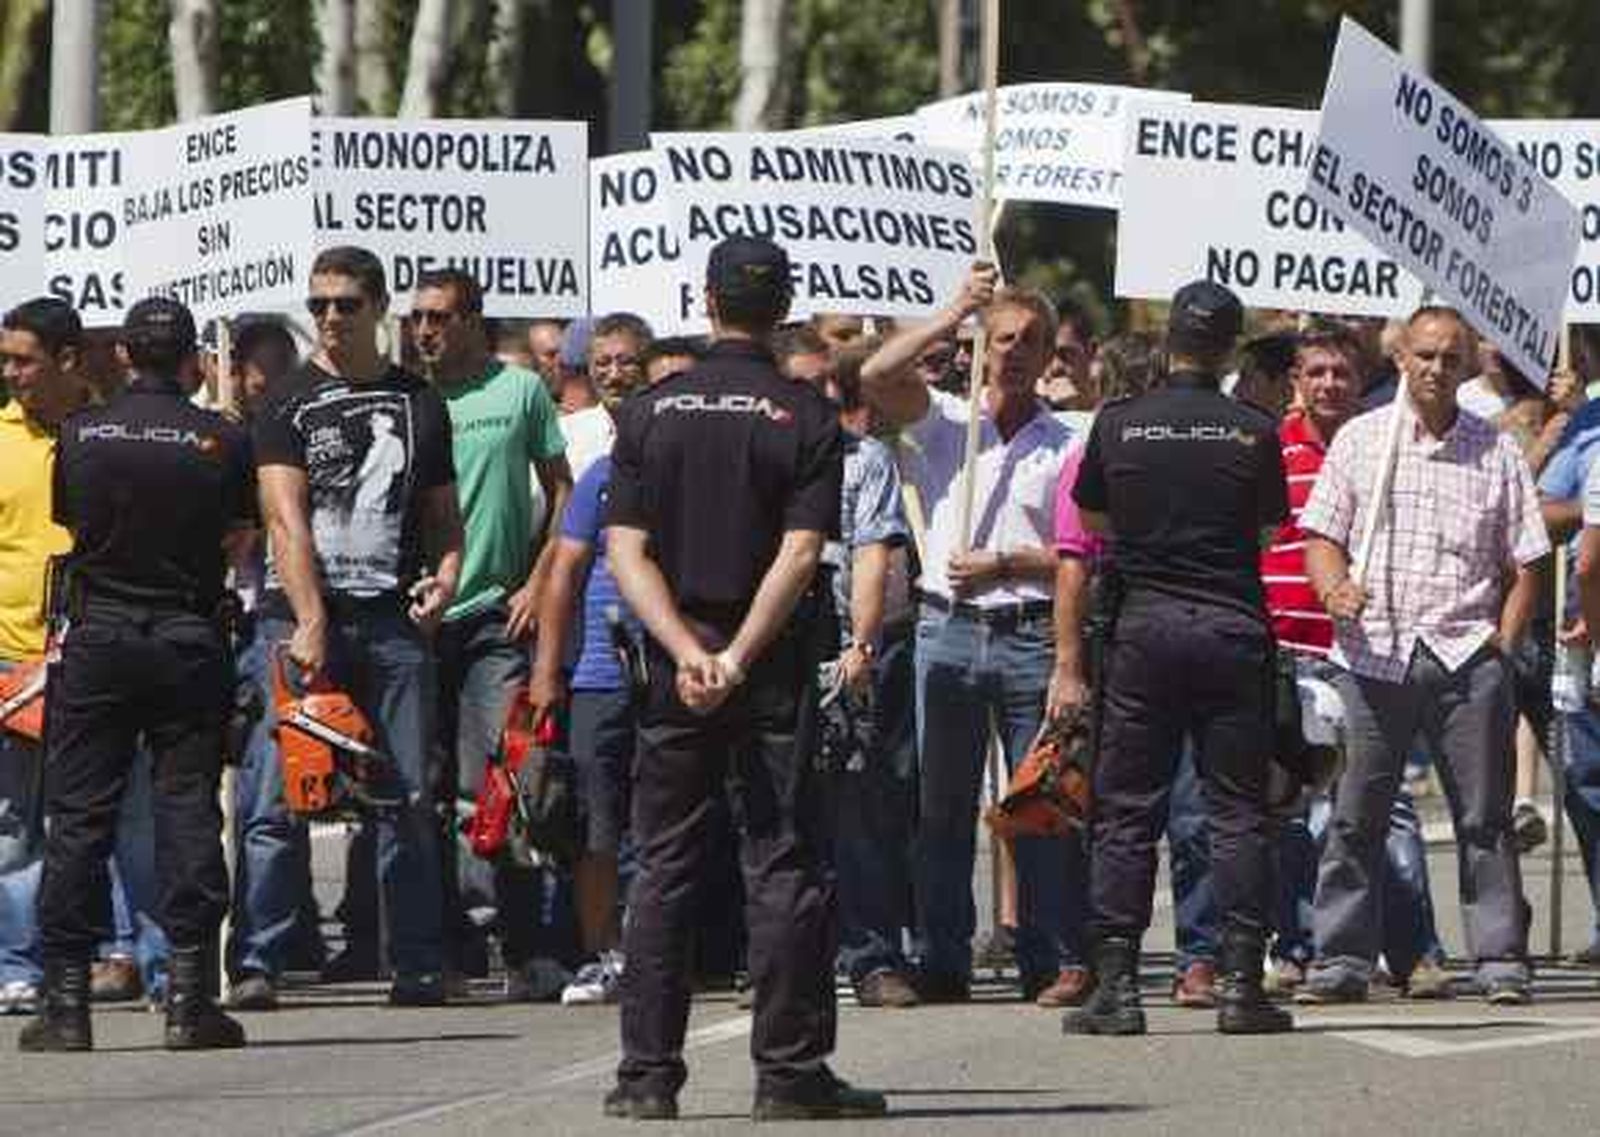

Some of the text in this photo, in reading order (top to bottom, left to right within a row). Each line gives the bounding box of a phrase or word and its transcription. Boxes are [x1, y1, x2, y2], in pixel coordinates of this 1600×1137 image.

[186, 125, 236, 163] ENCE
[334, 132, 556, 173] MONOPOLIZA
[1136, 117, 1316, 170] ENCE CH
[1395, 73, 1534, 213] NO SOMOS 3
[1575, 141, 1600, 180] S
[0, 151, 36, 188] S
[124, 154, 309, 226] BAJA LOS PRECIOS
[600, 168, 657, 208] NO
[667, 146, 973, 199] NO ADMITIMOS
[354, 193, 486, 232] SECTOR
[1413, 154, 1495, 245] SOMOS
[198, 221, 230, 256] SIN
[688, 204, 977, 255] ACUSACIONES
[1206, 245, 1401, 299] NO PAGAR
[1312, 144, 1549, 368] EL SECTOR FORESTAL
[1572, 265, 1600, 304] O
